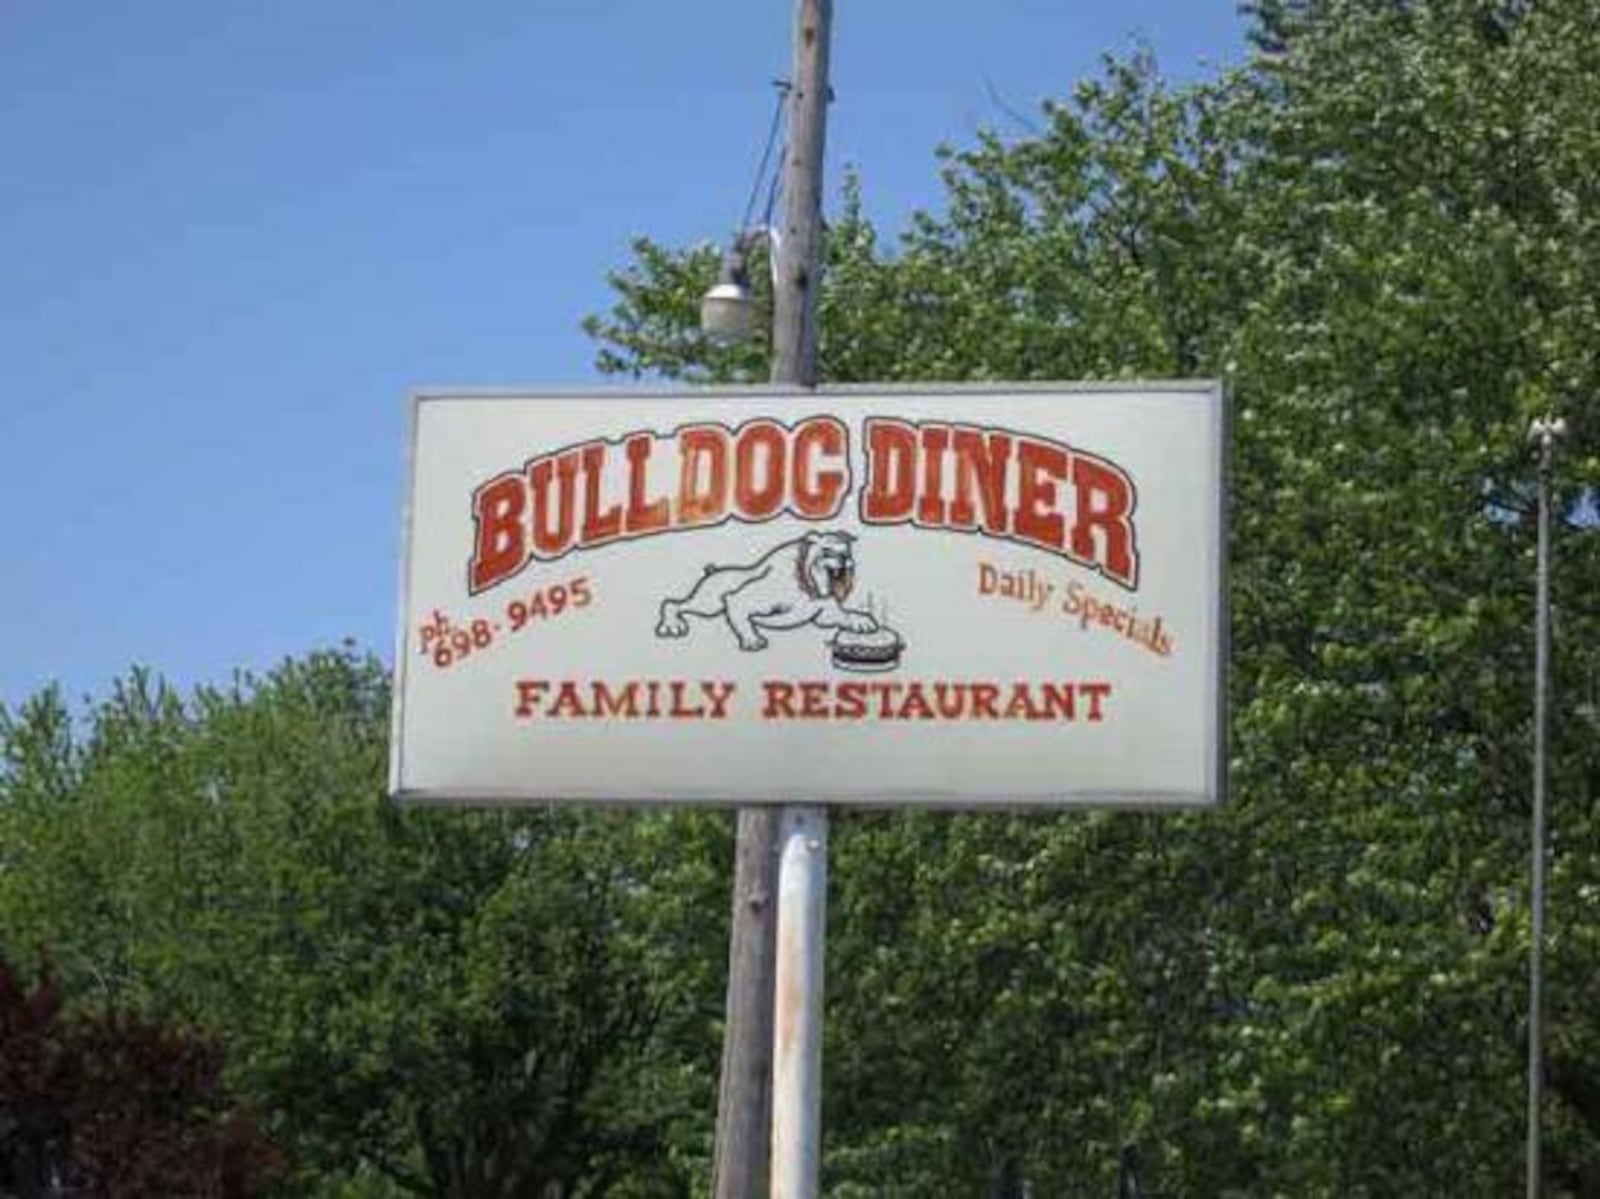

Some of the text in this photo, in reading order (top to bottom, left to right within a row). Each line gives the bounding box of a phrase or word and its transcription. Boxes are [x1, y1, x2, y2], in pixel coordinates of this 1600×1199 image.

[468, 416, 1139, 595] BULLDOG DINER
[978, 562, 1173, 656] Daily Specials
[515, 682, 1111, 721] FAMILY RESTAURANT
